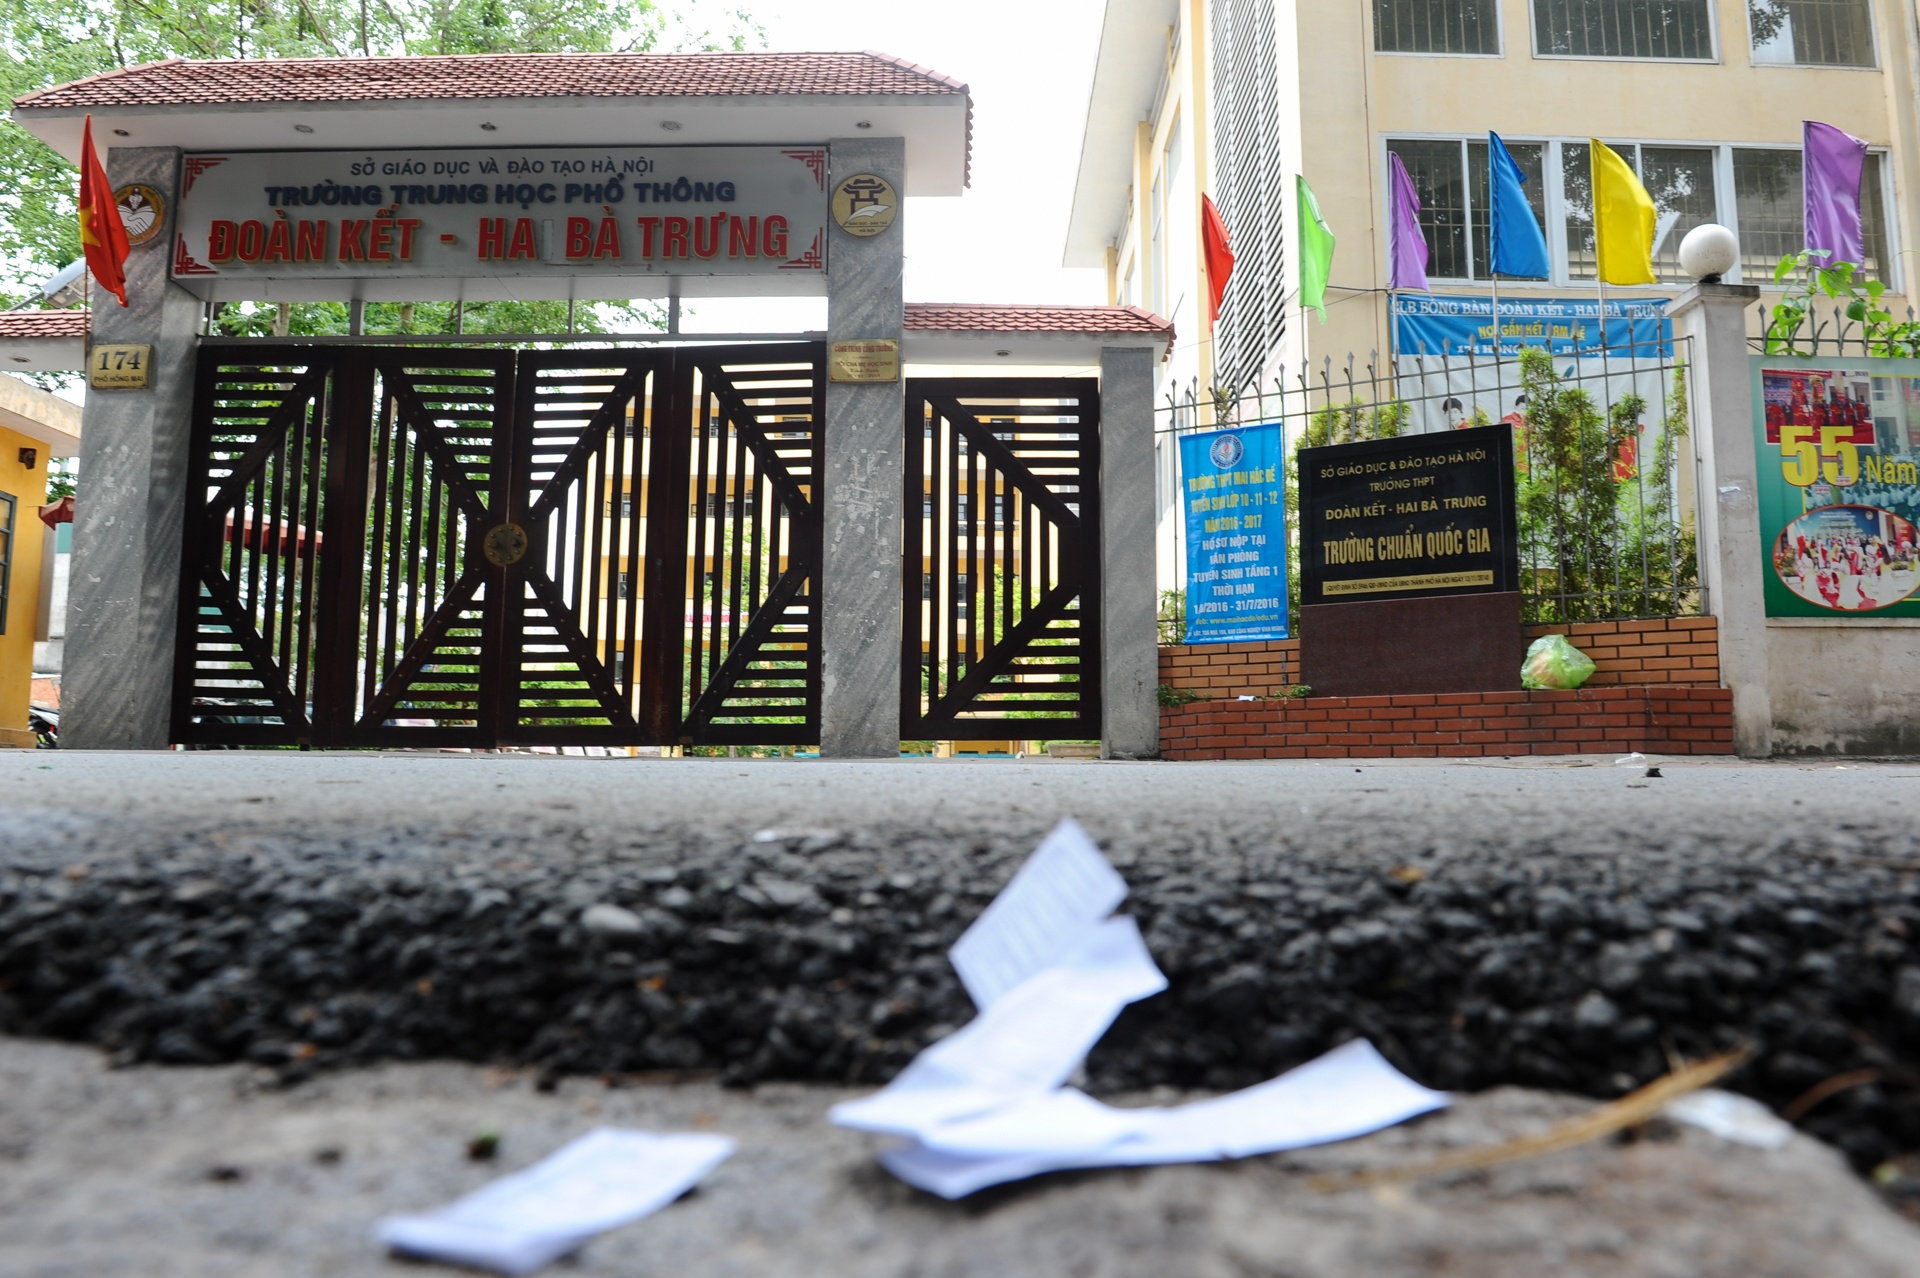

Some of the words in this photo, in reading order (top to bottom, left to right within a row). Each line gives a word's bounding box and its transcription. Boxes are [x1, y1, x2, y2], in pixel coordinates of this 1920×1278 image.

[350, 157, 375, 176] SỞ
[382, 158, 426, 176] GIÁO
[434, 162, 470, 179] DỤC
[478, 157, 499, 174] VÀ
[508, 156, 545, 174] ĐÀO
[550, 161, 585, 178] TẠO
[592, 156, 616, 173] HÀ
[624, 159, 654, 177] NỘI
[265, 179, 382, 206] TRƯỜNG
[390, 184, 489, 204] TRUNG
[494, 183, 556, 209] HỌC
[564, 172, 625, 204] PHỔ
[634, 176, 736, 203] THÔNG
[208, 209, 328, 264] ĐOÀN
[338, 203, 420, 262] KẾT
[440, 234, 456, 244] -
[565, 206, 622, 260] BÀ
[636, 211, 790, 260] TRƯNG
[1462, 300, 1490, 314] BÀN
[1537, 300, 1564, 315] KẾT
[1604, 302, 1622, 317] BÀ
[98, 350, 141, 370] 174
[1321, 465, 1335, 479] SỞ
[1337, 462, 1363, 476] GIÁO
[1366, 462, 1387, 475] DỤC
[1390, 461, 1397, 470] &
[1399, 456, 1423, 469] ĐÀO
[1425, 456, 1446, 468] TẠO
[1449, 450, 1464, 464] HÀ
[1466, 448, 1486, 463] NỘI
[1780, 425, 1860, 488] 55
[1865, 454, 1918, 486] Năm
[1234, 471, 1248, 485] MAI
[1369, 477, 1411, 492] TRƯỜNG
[1413, 476, 1435, 488] THPT
[1227, 490, 1239, 508] LỚP
[1240, 493, 1249, 506] 10
[1255, 492, 1262, 506] 11
[1269, 490, 1278, 504] 12
[1325, 504, 1360, 520] ĐOÀN
[1364, 500, 1386, 517] KẾT
[1396, 503, 1417, 514] HAI
[1421, 497, 1438, 512] BÀ
[1444, 495, 1487, 510] TRƯNG
[1221, 516, 1238, 530] 2016
[1244, 514, 1262, 528] 2017
[1230, 534, 1248, 549] NỘP
[1251, 535, 1266, 547] TẠI
[1324, 532, 1374, 564] TRƯỜNG
[1378, 524, 1423, 561] CHUẨN
[1426, 522, 1462, 559] QUỐC
[1467, 528, 1491, 554] GIA
[1228, 549, 1259, 563] PHÒNG
[1221, 568, 1243, 580] SINH
[1245, 564, 1270, 577] TẦNG
[1273, 566, 1278, 576] 1
[1212, 583, 1234, 596] THỜI
[1236, 583, 1255, 596] HẠN
[1236, 598, 1279, 611] 31/7/2016
